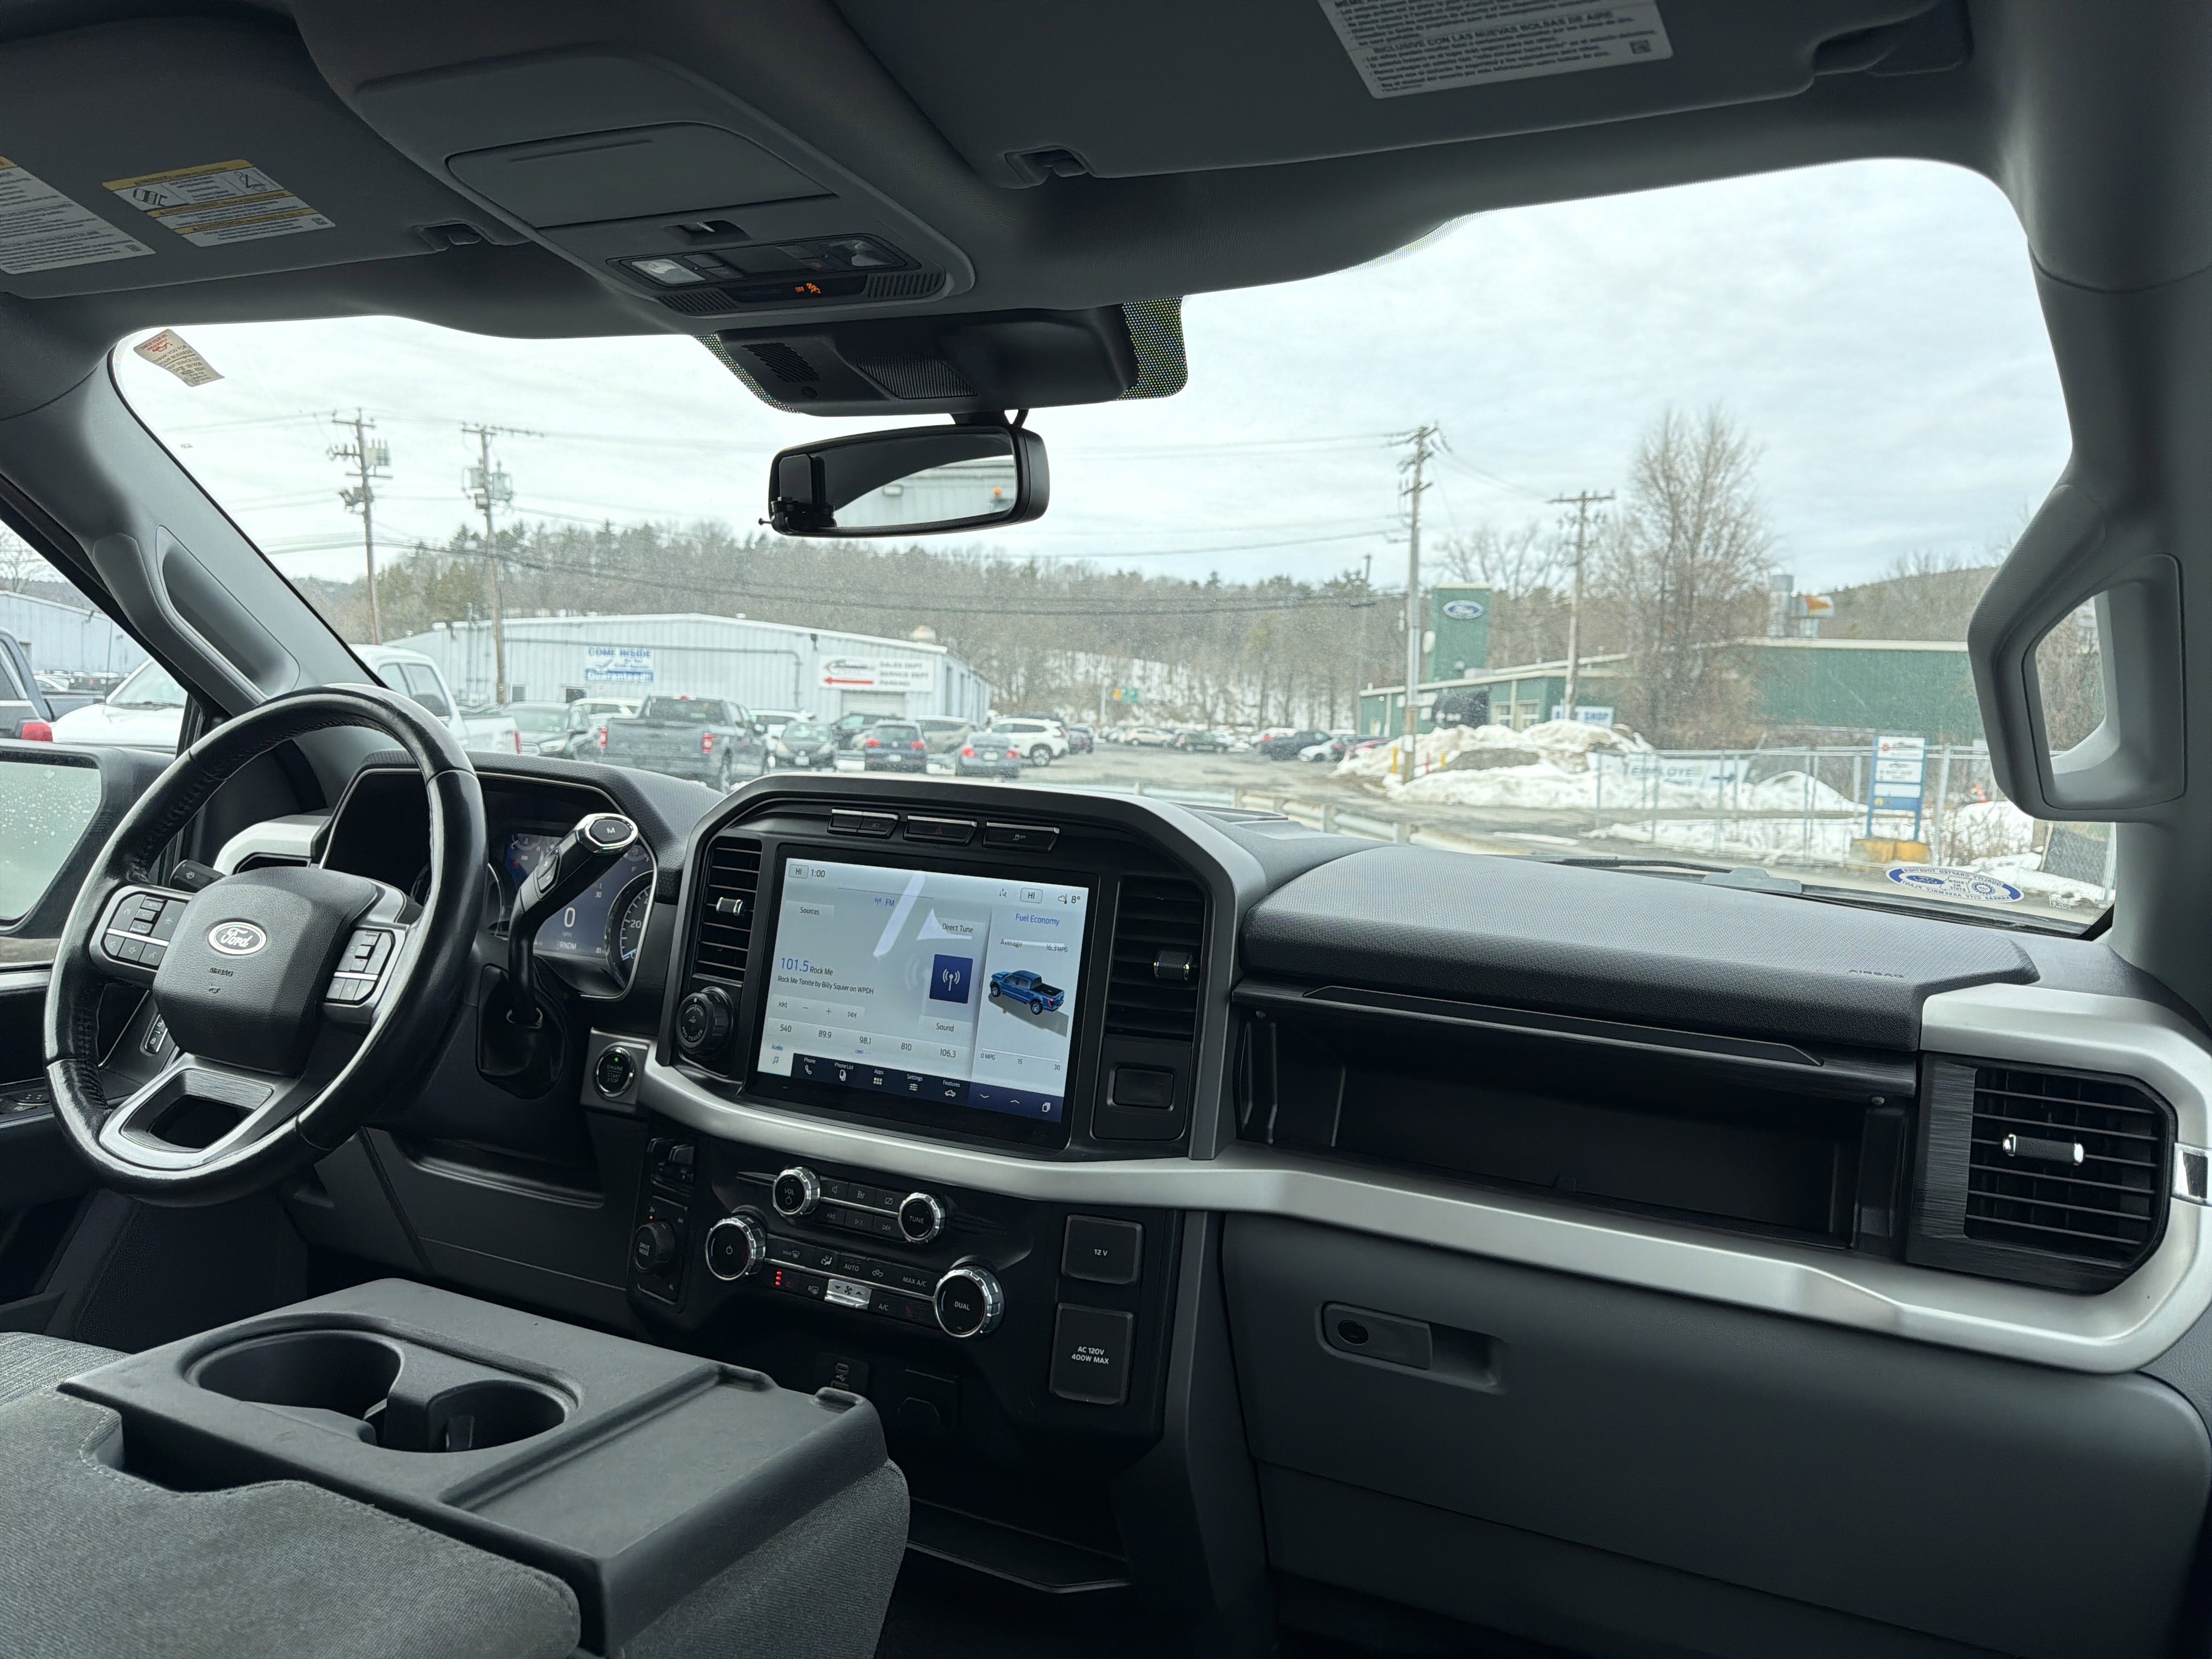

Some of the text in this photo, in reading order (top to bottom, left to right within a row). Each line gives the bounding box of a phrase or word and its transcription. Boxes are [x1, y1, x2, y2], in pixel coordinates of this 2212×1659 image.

[152, 337, 162, 345] YOUR
[167, 347, 178, 356] YOU
[588, 647, 652, 657] COME INSIDE
[810, 869, 826, 878] 1:00
[1028, 891, 1081, 904] HI 8°
[885, 899, 895, 907] FM
[800, 907, 820, 915] Sources
[564, 907, 575, 928] 0
[1015, 913, 1060, 927] Fuel Economy
[630, 920, 641, 929] 20
[942, 923, 974, 933] Direct Tune
[221, 927, 253, 947] Ford
[1000, 938, 1023, 948] Average
[781, 957, 809, 972] 101.5
[799, 978, 814, 986] Tonite
[821, 981, 833, 990] Billy
[833, 983, 849, 991] Squier
[857, 986, 874, 995] WPDH
[936, 1023, 955, 1032] Sound
[780, 1024, 956, 1058] 540 89.9 98.1 810 106.3
[906, 1074, 923, 1082] Settings
[943, 1080, 961, 1088] Features
[909, 1215, 925, 1224] TUNE
[843, 1263, 860, 1272] AUTO
[902, 1276, 927, 1288] MAX A/C
[878, 1304, 889, 1312] A/C
[953, 1301, 970, 1311] DUAL
[1088, 1347, 1105, 1355] 120V
[1071, 1353, 1109, 1365] 400W MAX
